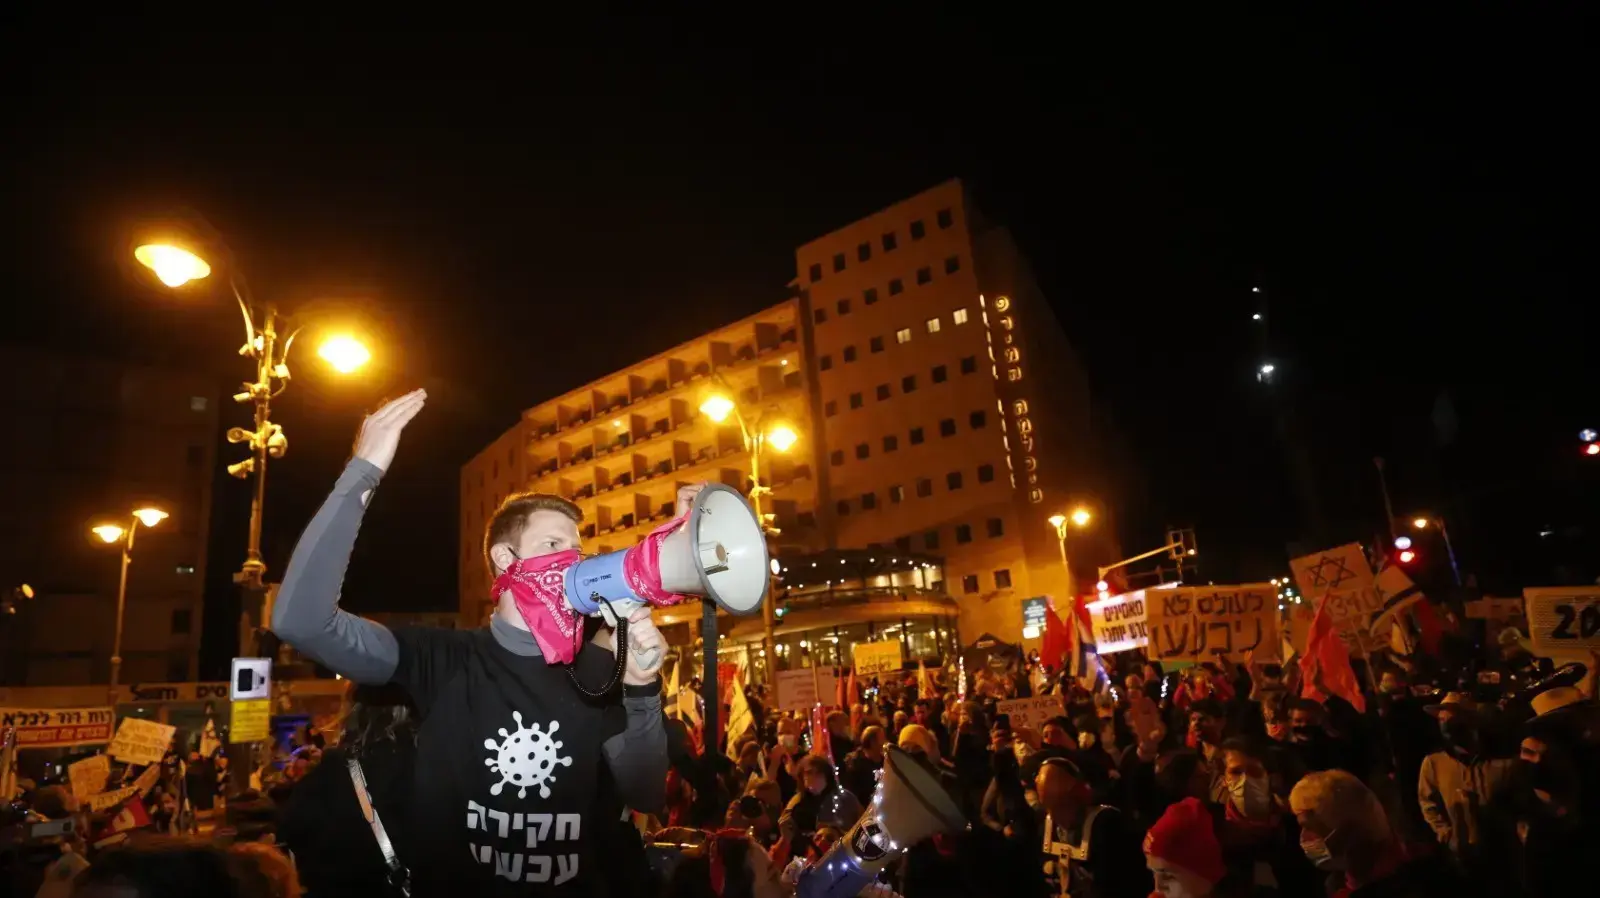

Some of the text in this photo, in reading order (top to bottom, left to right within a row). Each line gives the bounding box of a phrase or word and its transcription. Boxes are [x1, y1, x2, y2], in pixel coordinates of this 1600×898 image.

[1162, 592, 1264, 617] לעולם לא
[466, 799, 581, 849] חקירה
